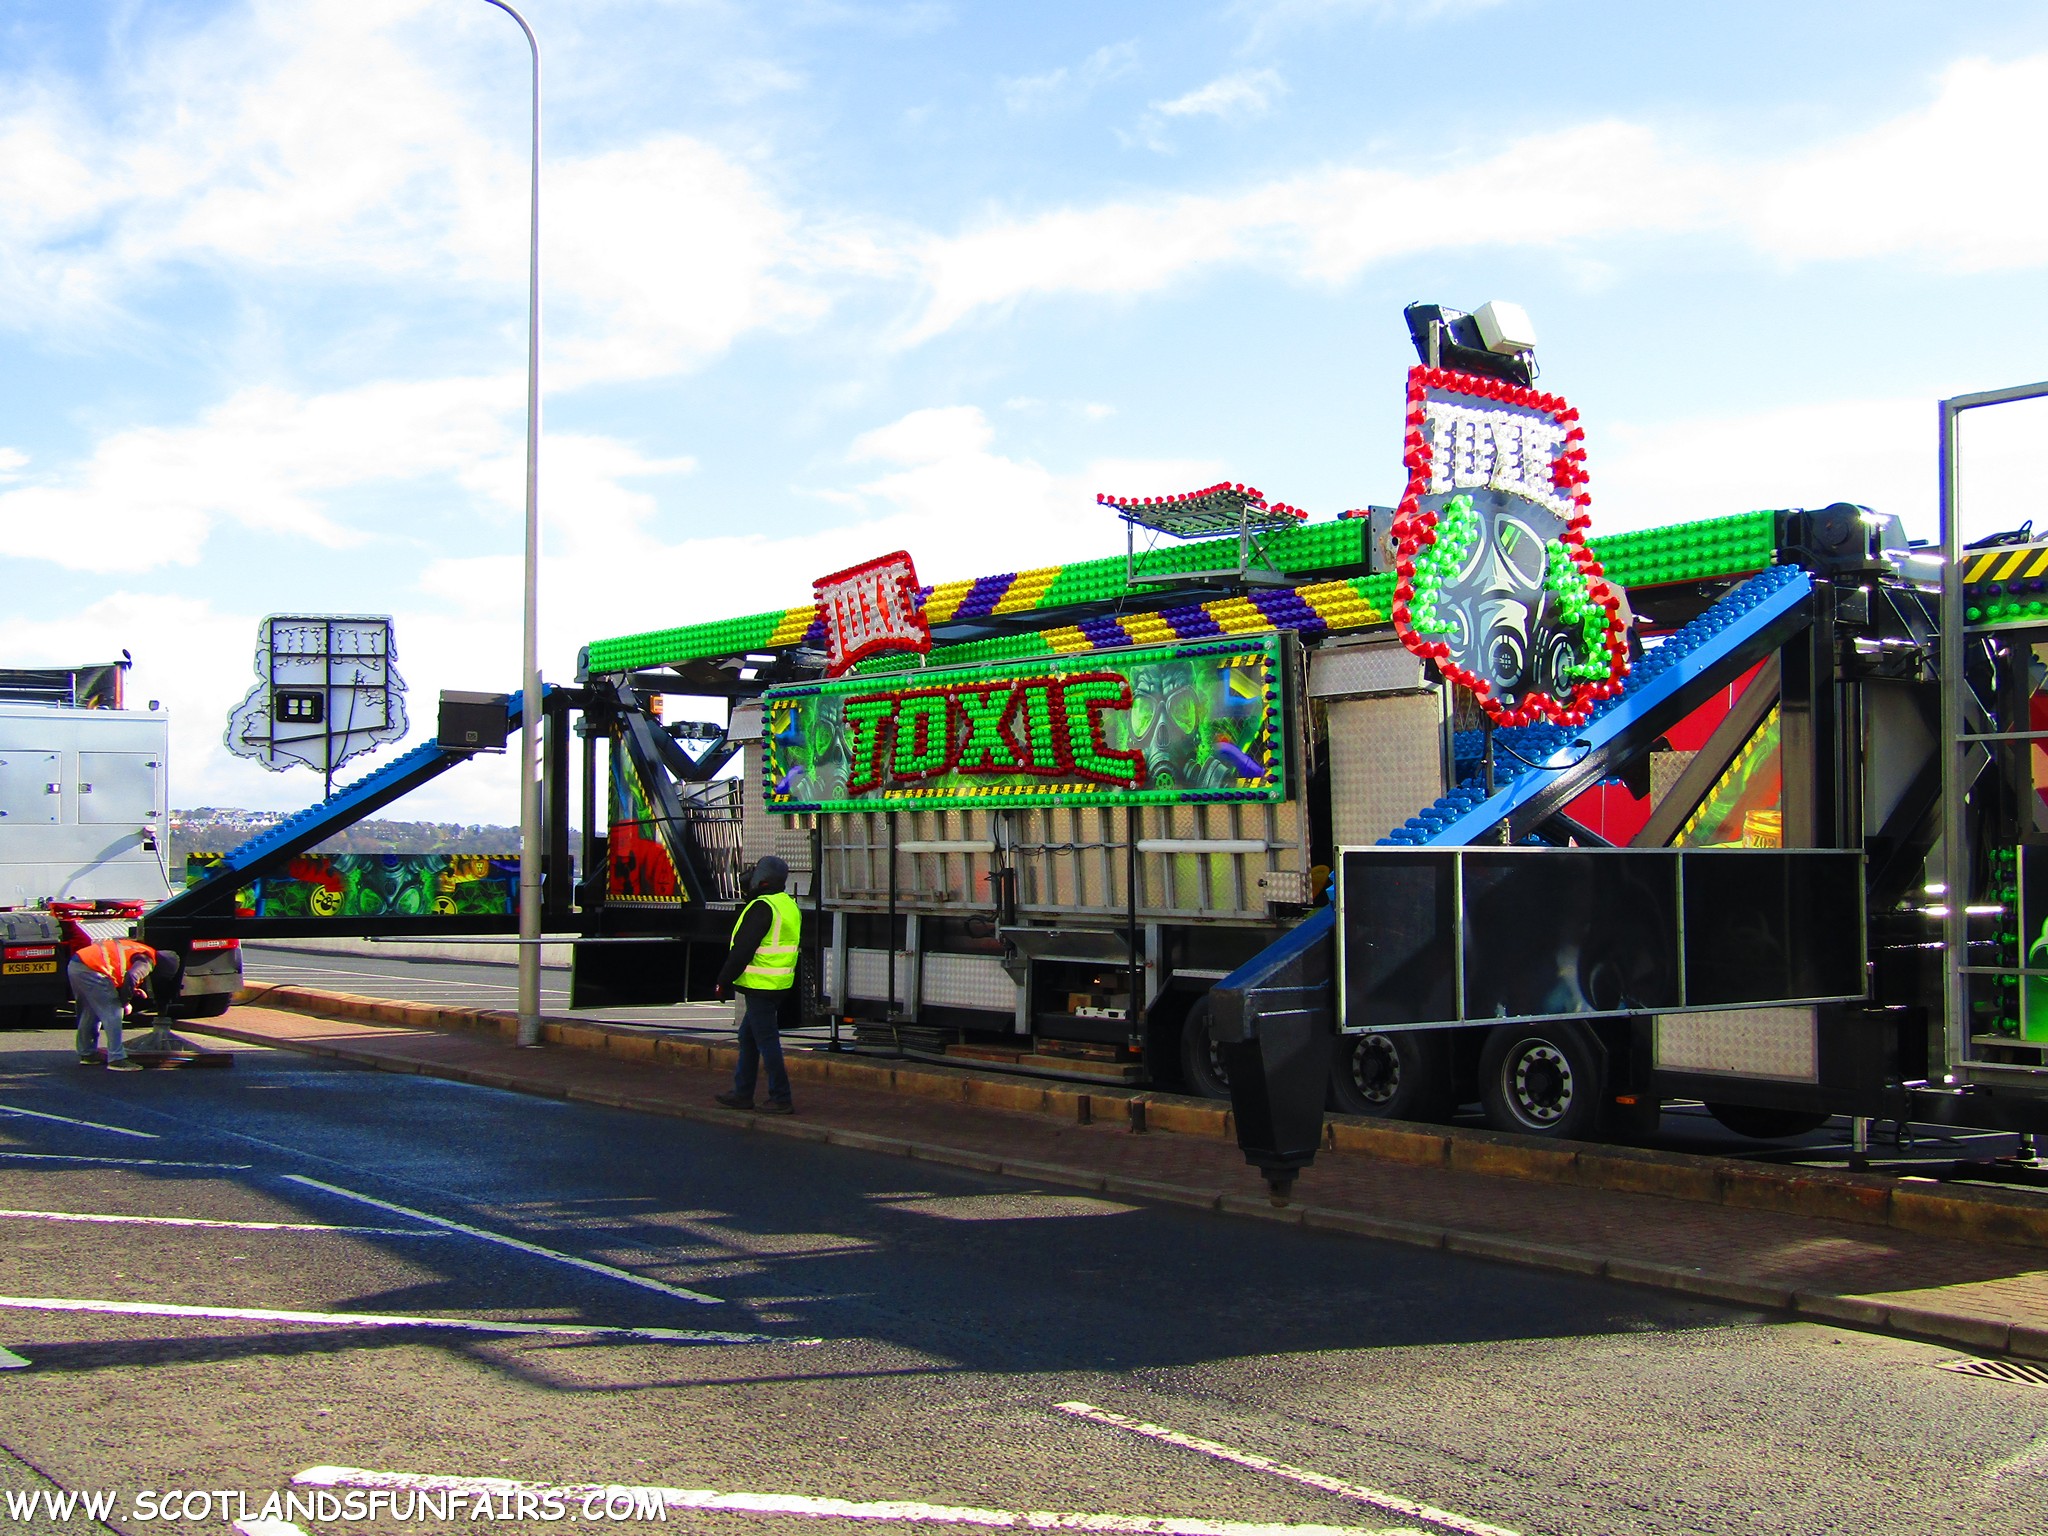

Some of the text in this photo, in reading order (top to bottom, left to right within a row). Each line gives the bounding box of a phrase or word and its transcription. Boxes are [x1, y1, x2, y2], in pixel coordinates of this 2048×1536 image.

[1427, 401, 1575, 520] TOXIC
[817, 561, 925, 666] TOXIC
[843, 672, 1146, 796] TOXIC
[8, 962, 52, 973] KS16 XKT
